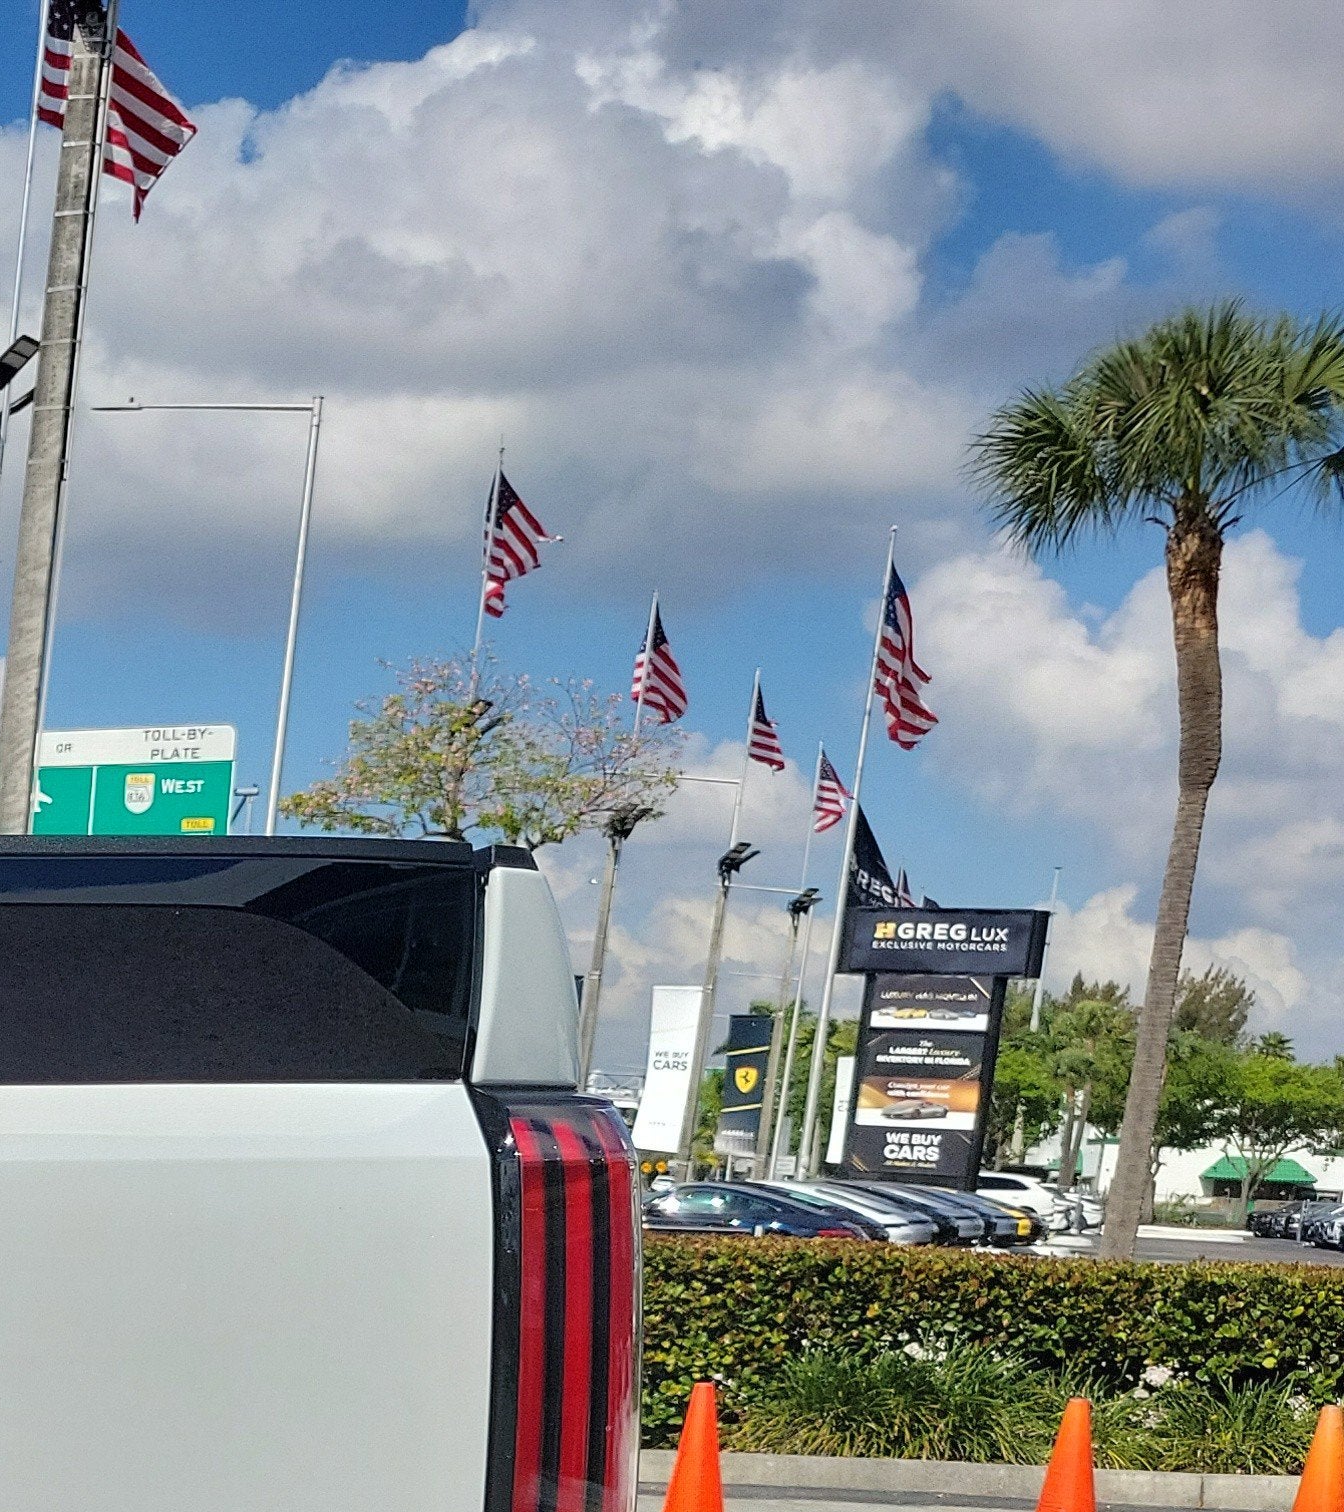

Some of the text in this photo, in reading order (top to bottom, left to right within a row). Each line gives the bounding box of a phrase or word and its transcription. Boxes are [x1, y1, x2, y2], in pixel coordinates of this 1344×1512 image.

[150, 747, 200, 760] PLATE
[161, 778, 205, 794] WEST
[970, 927, 1009, 941] LUX
[872, 940, 1007, 952] EXCLUSIVE MOTORCARS
[653, 1060, 688, 1071] CARS
[886, 1132, 942, 1146] WE BUY
[883, 1145, 940, 1161] CARS
